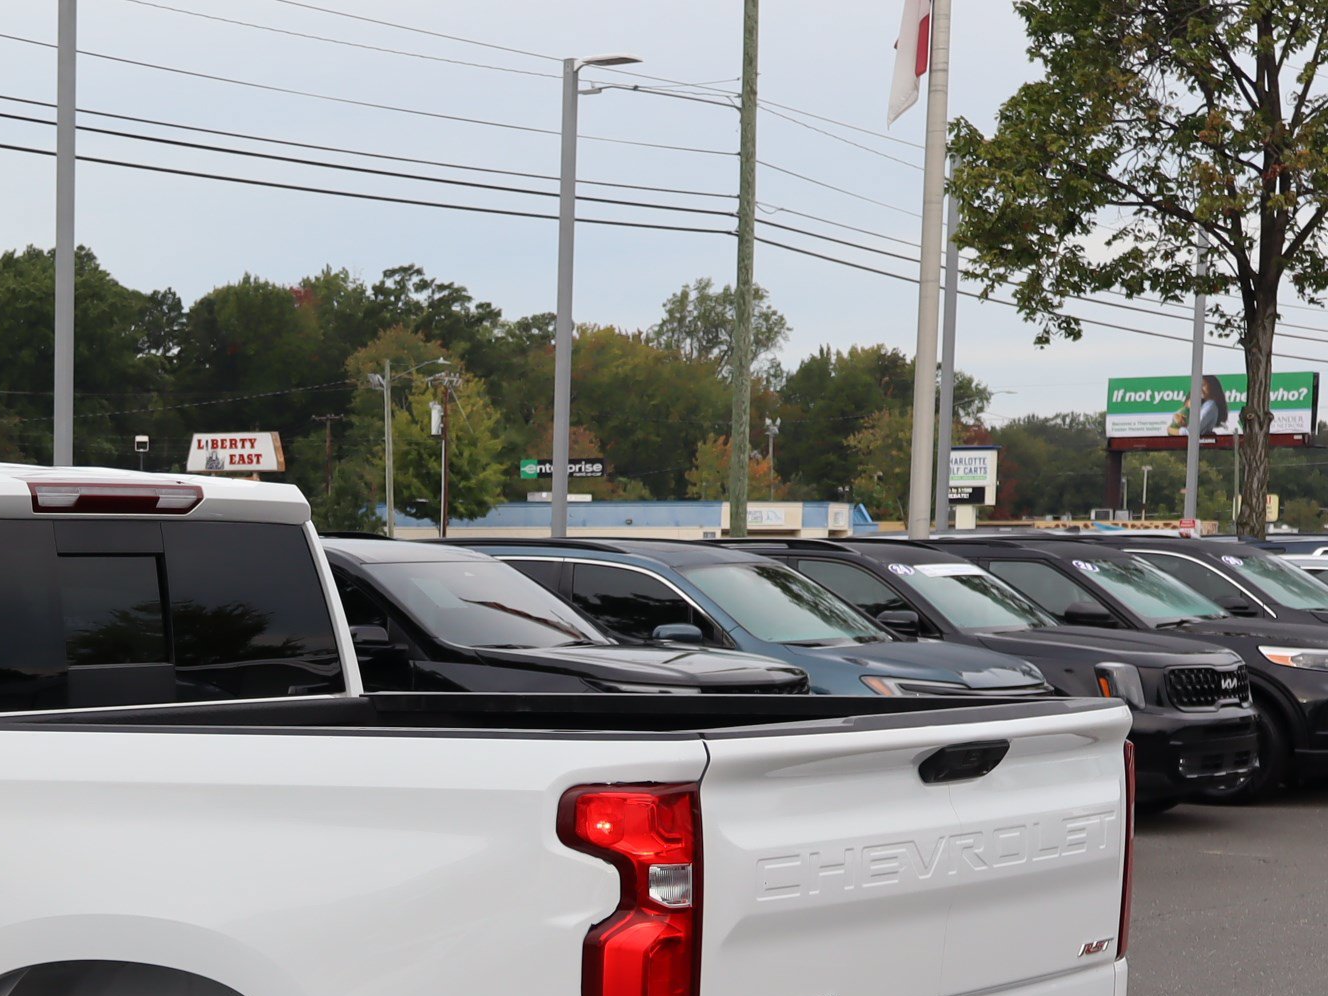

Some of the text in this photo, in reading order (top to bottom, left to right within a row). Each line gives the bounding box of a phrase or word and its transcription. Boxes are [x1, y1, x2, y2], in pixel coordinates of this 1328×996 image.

[1112, 389, 1125, 402] If
[1125, 389, 1152, 402] not
[1153, 390, 1186, 405] you,
[1225, 389, 1248, 402] the
[196, 438, 257, 450] LIBERTY
[229, 453, 263, 465] EAST
[950, 457, 987, 465] HARLOTTE
[521, 461, 603, 475] entprise
[950, 466, 988, 475] LF CARTS
[756, 809, 1117, 901] CHEVROLET
